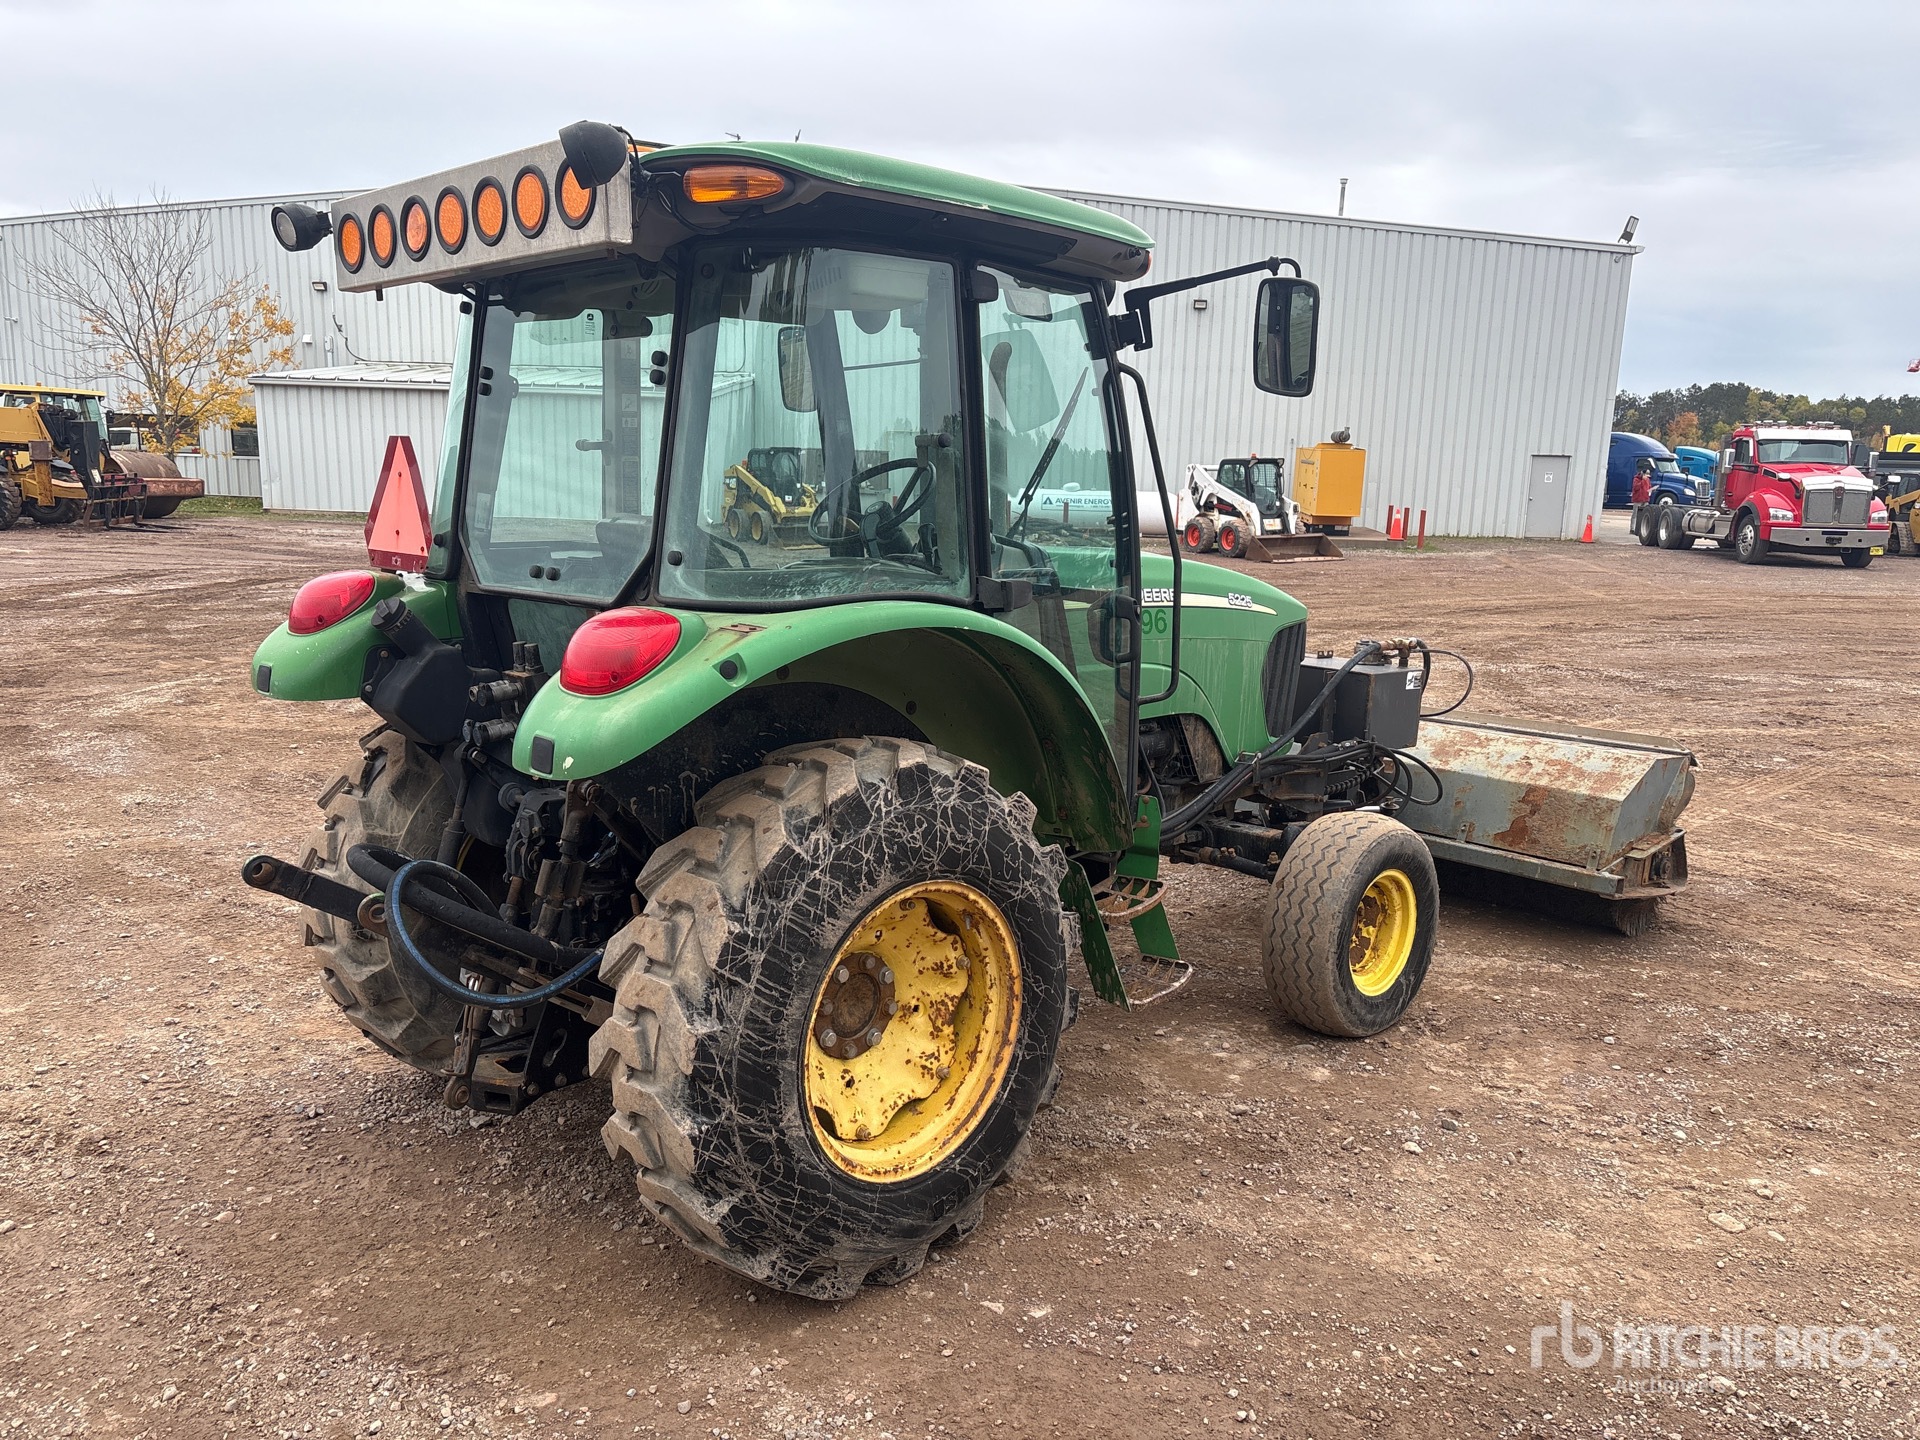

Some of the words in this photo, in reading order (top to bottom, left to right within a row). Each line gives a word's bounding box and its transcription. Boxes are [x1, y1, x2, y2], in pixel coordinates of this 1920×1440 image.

[1055, 497, 1083, 505] AVENIR
[1141, 588, 1174, 602] EERE
[1228, 592, 1253, 608] 5225
[1142, 608, 1168, 635] 96
